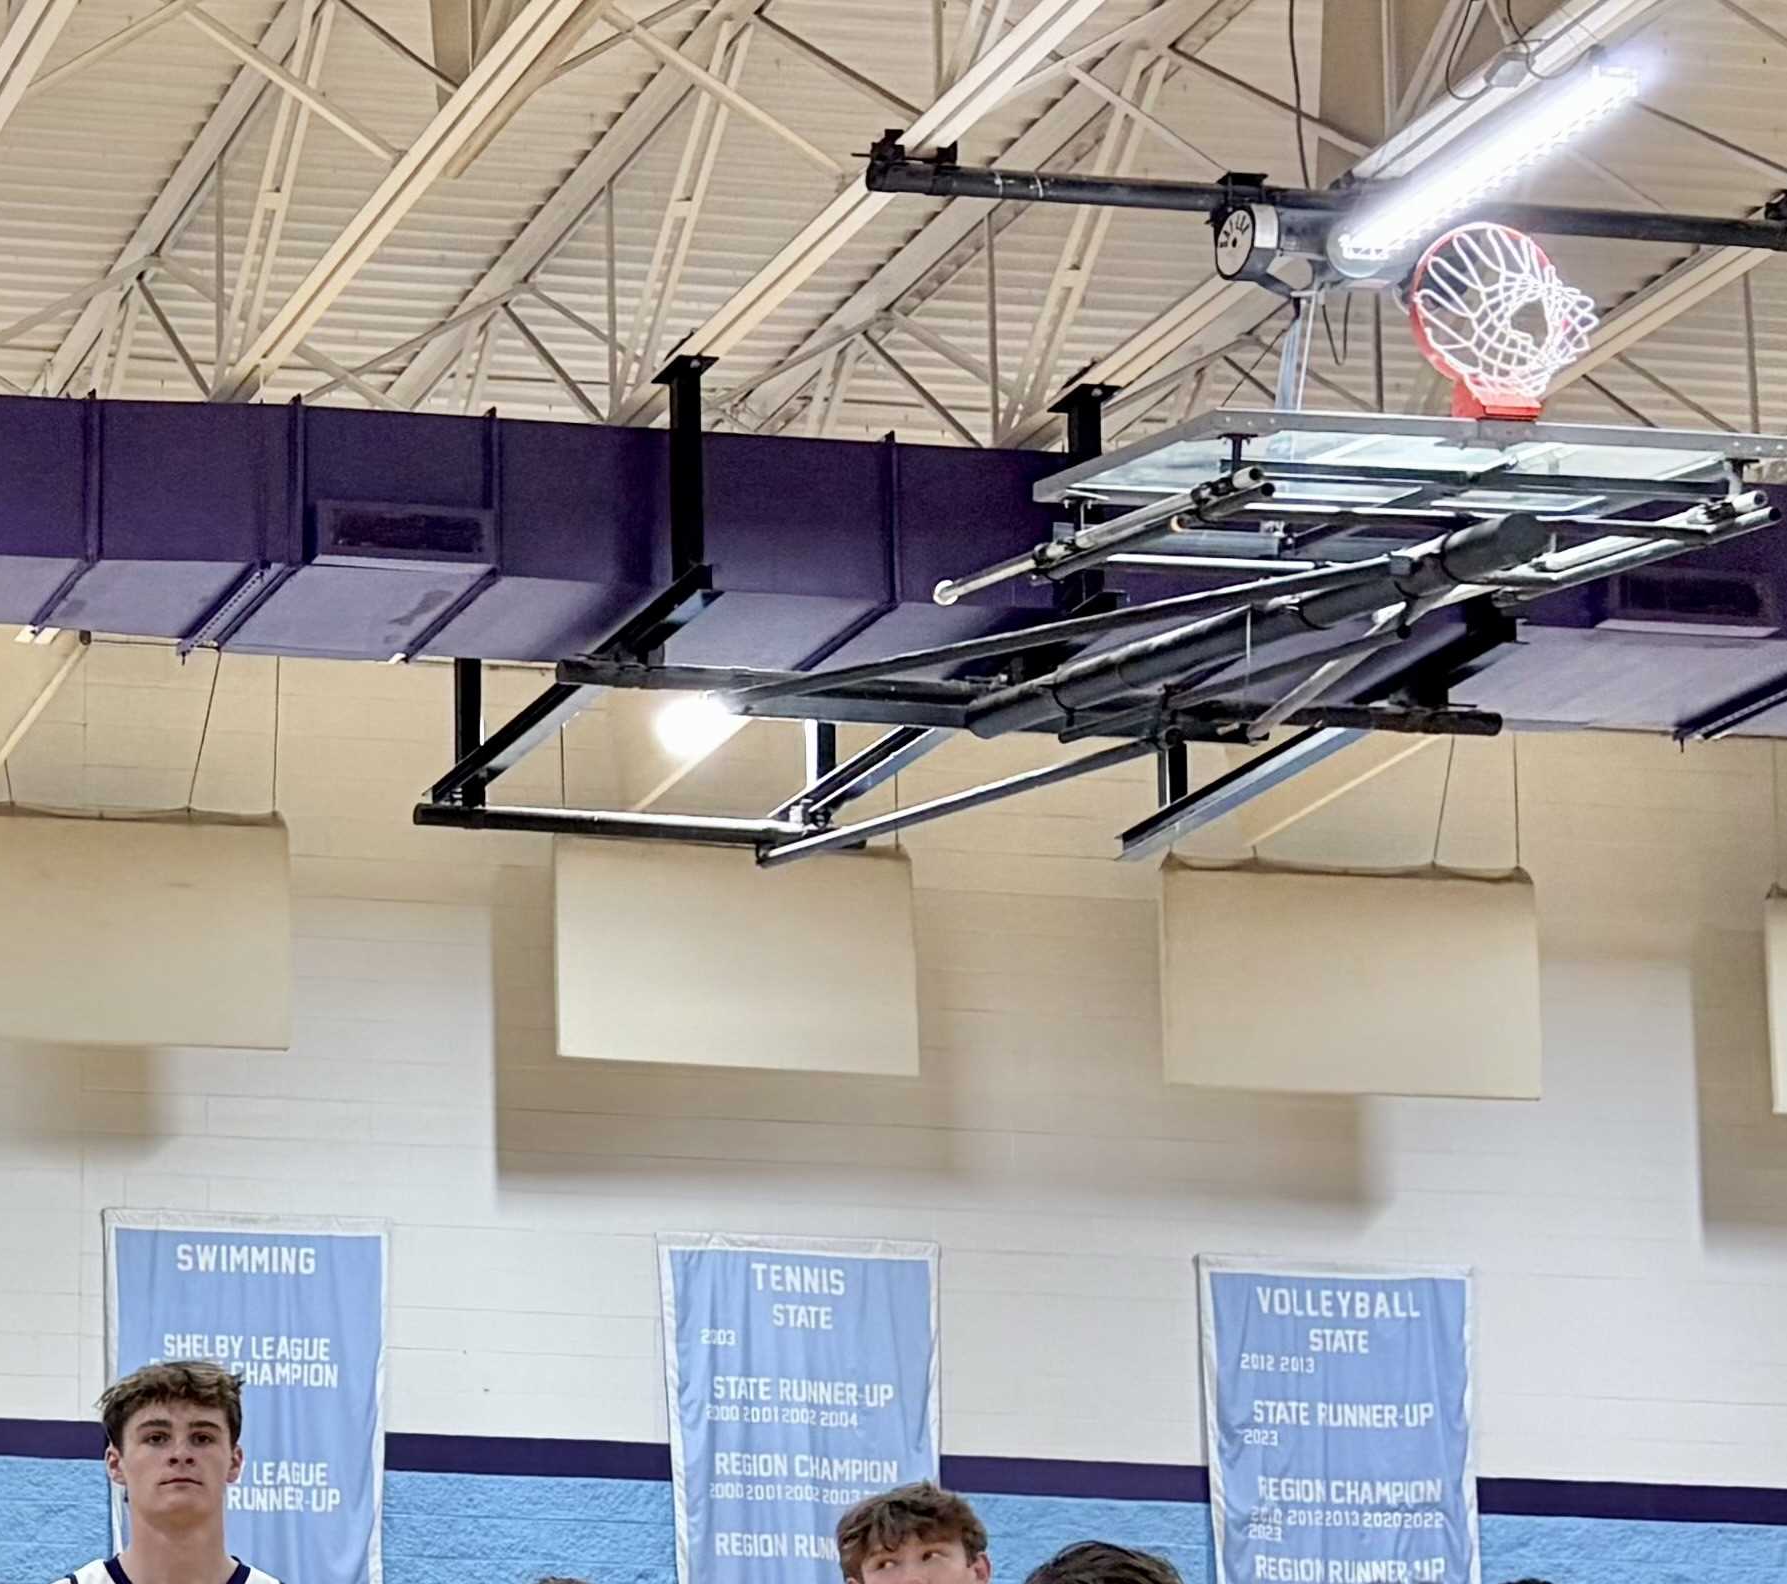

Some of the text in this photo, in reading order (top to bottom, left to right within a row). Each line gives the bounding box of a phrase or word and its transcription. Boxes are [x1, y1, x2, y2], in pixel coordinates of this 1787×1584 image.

[176, 1244, 316, 1275] SWIMMING
[751, 1263, 845, 1296] TENNIS
[1257, 1286, 1421, 1318] VOLLEYBALL
[772, 1304, 833, 1330] STATE
[163, 1333, 331, 1361] SHELBY LEAGUE
[1309, 1329, 1370, 1353] STATE
[1240, 1353, 1315, 1374] 2012 2013
[713, 1376, 894, 1408] STATE RUNNER-UP
[820, 1410, 858, 1428] 2004
[1253, 1400, 1434, 1428] STATE RUNNER-UP
[252, 1461, 329, 1486] LEAGUE
[715, 1452, 897, 1483] REGION CHAMPION
[227, 1486, 341, 1513] RUNNER-UP
[1258, 1476, 1442, 1506] REGION CHAMPION
[715, 1532, 788, 1558] REGION
[1255, 1555, 1325, 1582] REGION
